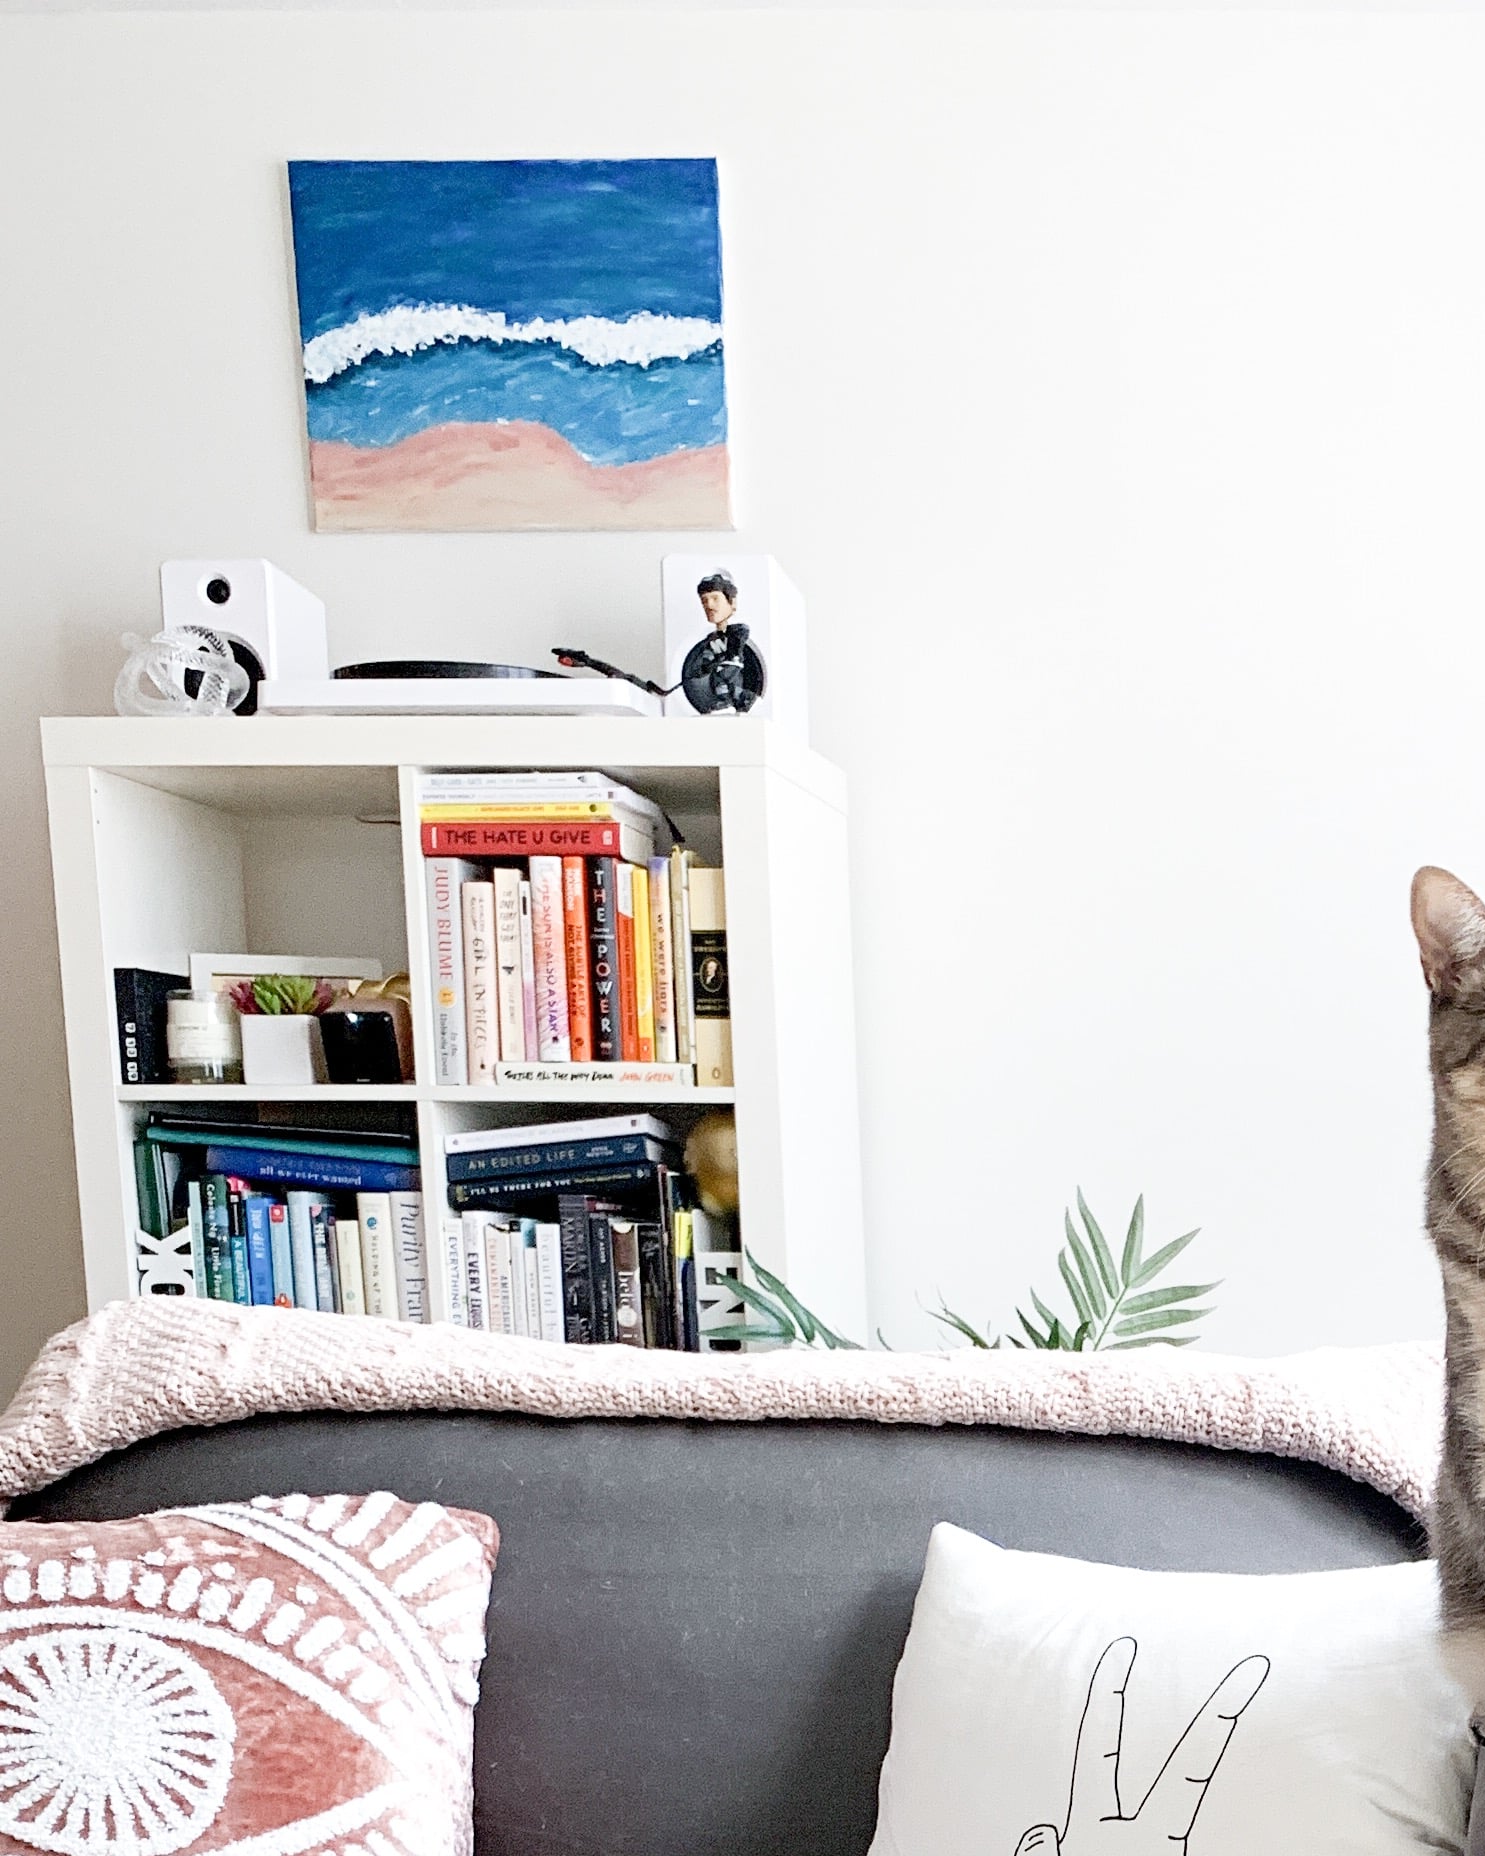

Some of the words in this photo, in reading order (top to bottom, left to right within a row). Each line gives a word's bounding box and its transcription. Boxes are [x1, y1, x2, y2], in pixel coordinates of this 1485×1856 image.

[445, 830, 477, 845] THE
[484, 830, 527, 845] HATE
[532, 830, 544, 845] U
[549, 830, 591, 845] GIVE
[434, 866, 449, 912] JUDY
[592, 870, 607, 922] THE
[543, 906, 553, 934] SUN
[567, 924, 576, 945] NOT
[576, 924, 584, 942] THE
[656, 913, 666, 932] we
[437, 919, 454, 980] BLUME
[473, 937, 486, 976] GIRL
[576, 946, 584, 980] SUBTLE
[658, 940, 666, 975] were
[546, 953, 556, 984] ALSO
[474, 984, 486, 1001] IN
[548, 988, 556, 998] A
[577, 984, 585, 1003] ART
[595, 944, 614, 1032] POWER
[549, 1001, 558, 1032] STAR
[578, 1004, 586, 1018] OF
[552, 1072, 568, 1081] THE
[468, 1156, 486, 1170] AN
[490, 1153, 542, 1169] EDITED
[546, 1149, 576, 1163] LIFE
[504, 1182, 532, 1192] THERE
[534, 1180, 552, 1189] FOR
[206, 1183, 217, 1220] Celeste
[208, 1222, 218, 1239] Ng
[234, 1240, 242, 1248] A
[314, 1222, 326, 1244] THE
[400, 1203, 423, 1268] Purity
[448, 1236, 461, 1309] EVERYTHING
[468, 1252, 482, 1294] EVERY
[488, 1238, 500, 1298] CHIMAMANDA
[542, 1233, 558, 1314] beautiful
